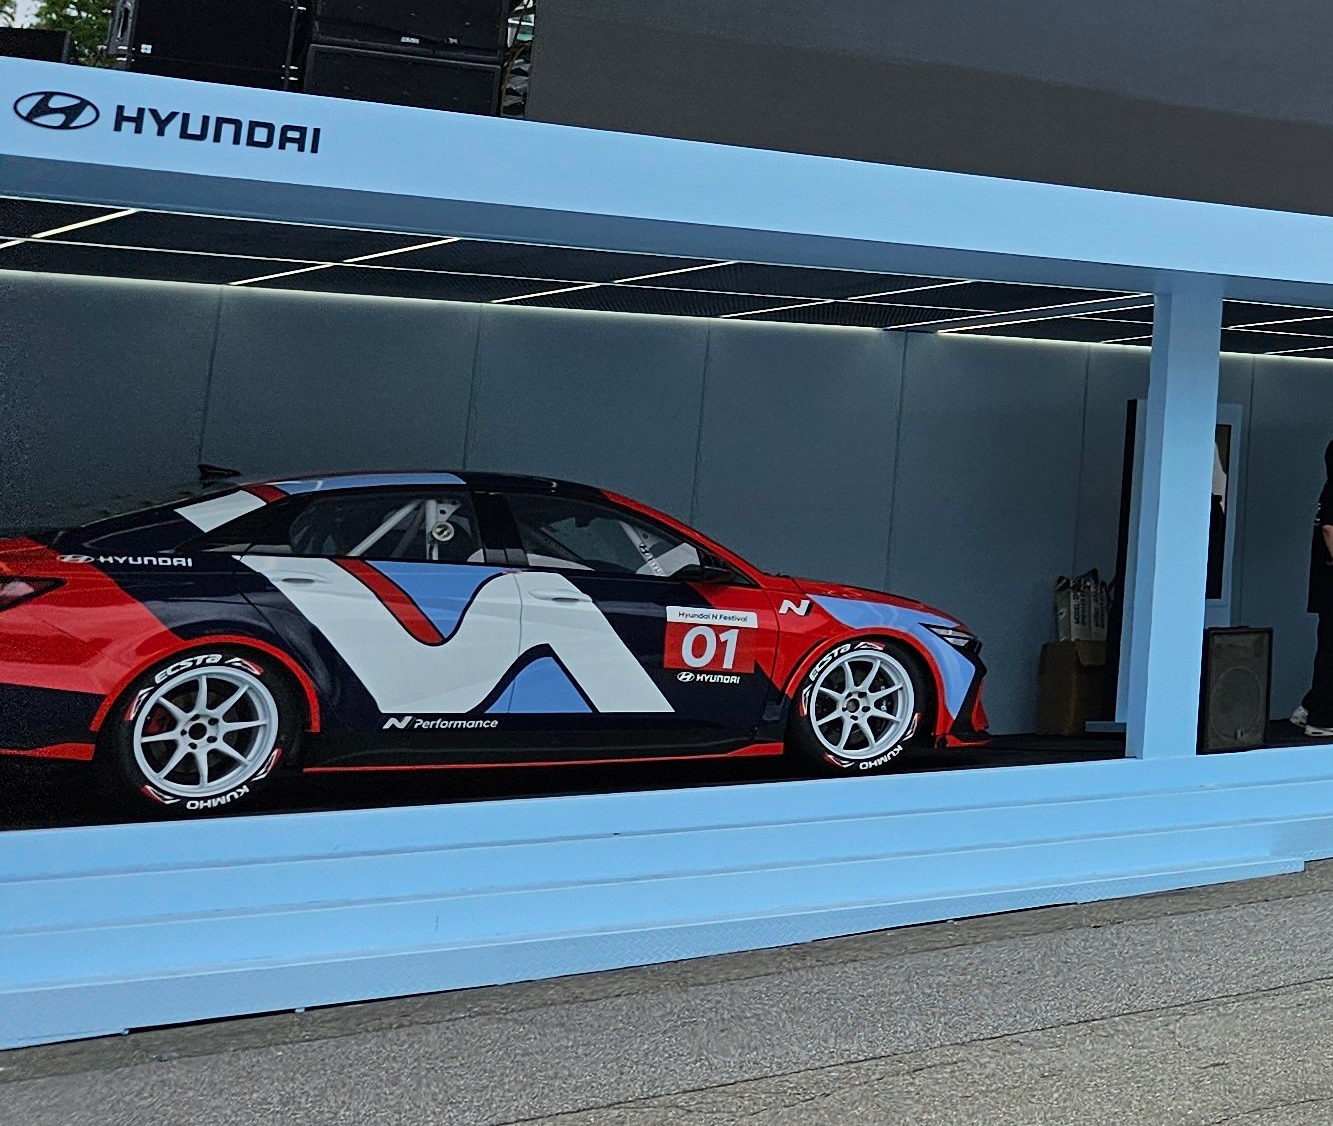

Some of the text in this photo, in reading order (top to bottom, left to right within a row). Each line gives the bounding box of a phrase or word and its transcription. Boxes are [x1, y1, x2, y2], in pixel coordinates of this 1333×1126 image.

[113, 104, 321, 154] HYUNDAI
[98, 555, 193, 567] HYUNDAI
[779, 599, 811, 616] N
[678, 611, 748, 623] Hyundai N Festival
[681, 625, 740, 670] 01
[695, 673, 741, 685] HYUNDAI
[382, 715, 499, 730] N Performance
[859, 744, 903, 770] KUMHO
[186, 784, 250, 810] KUMHO
